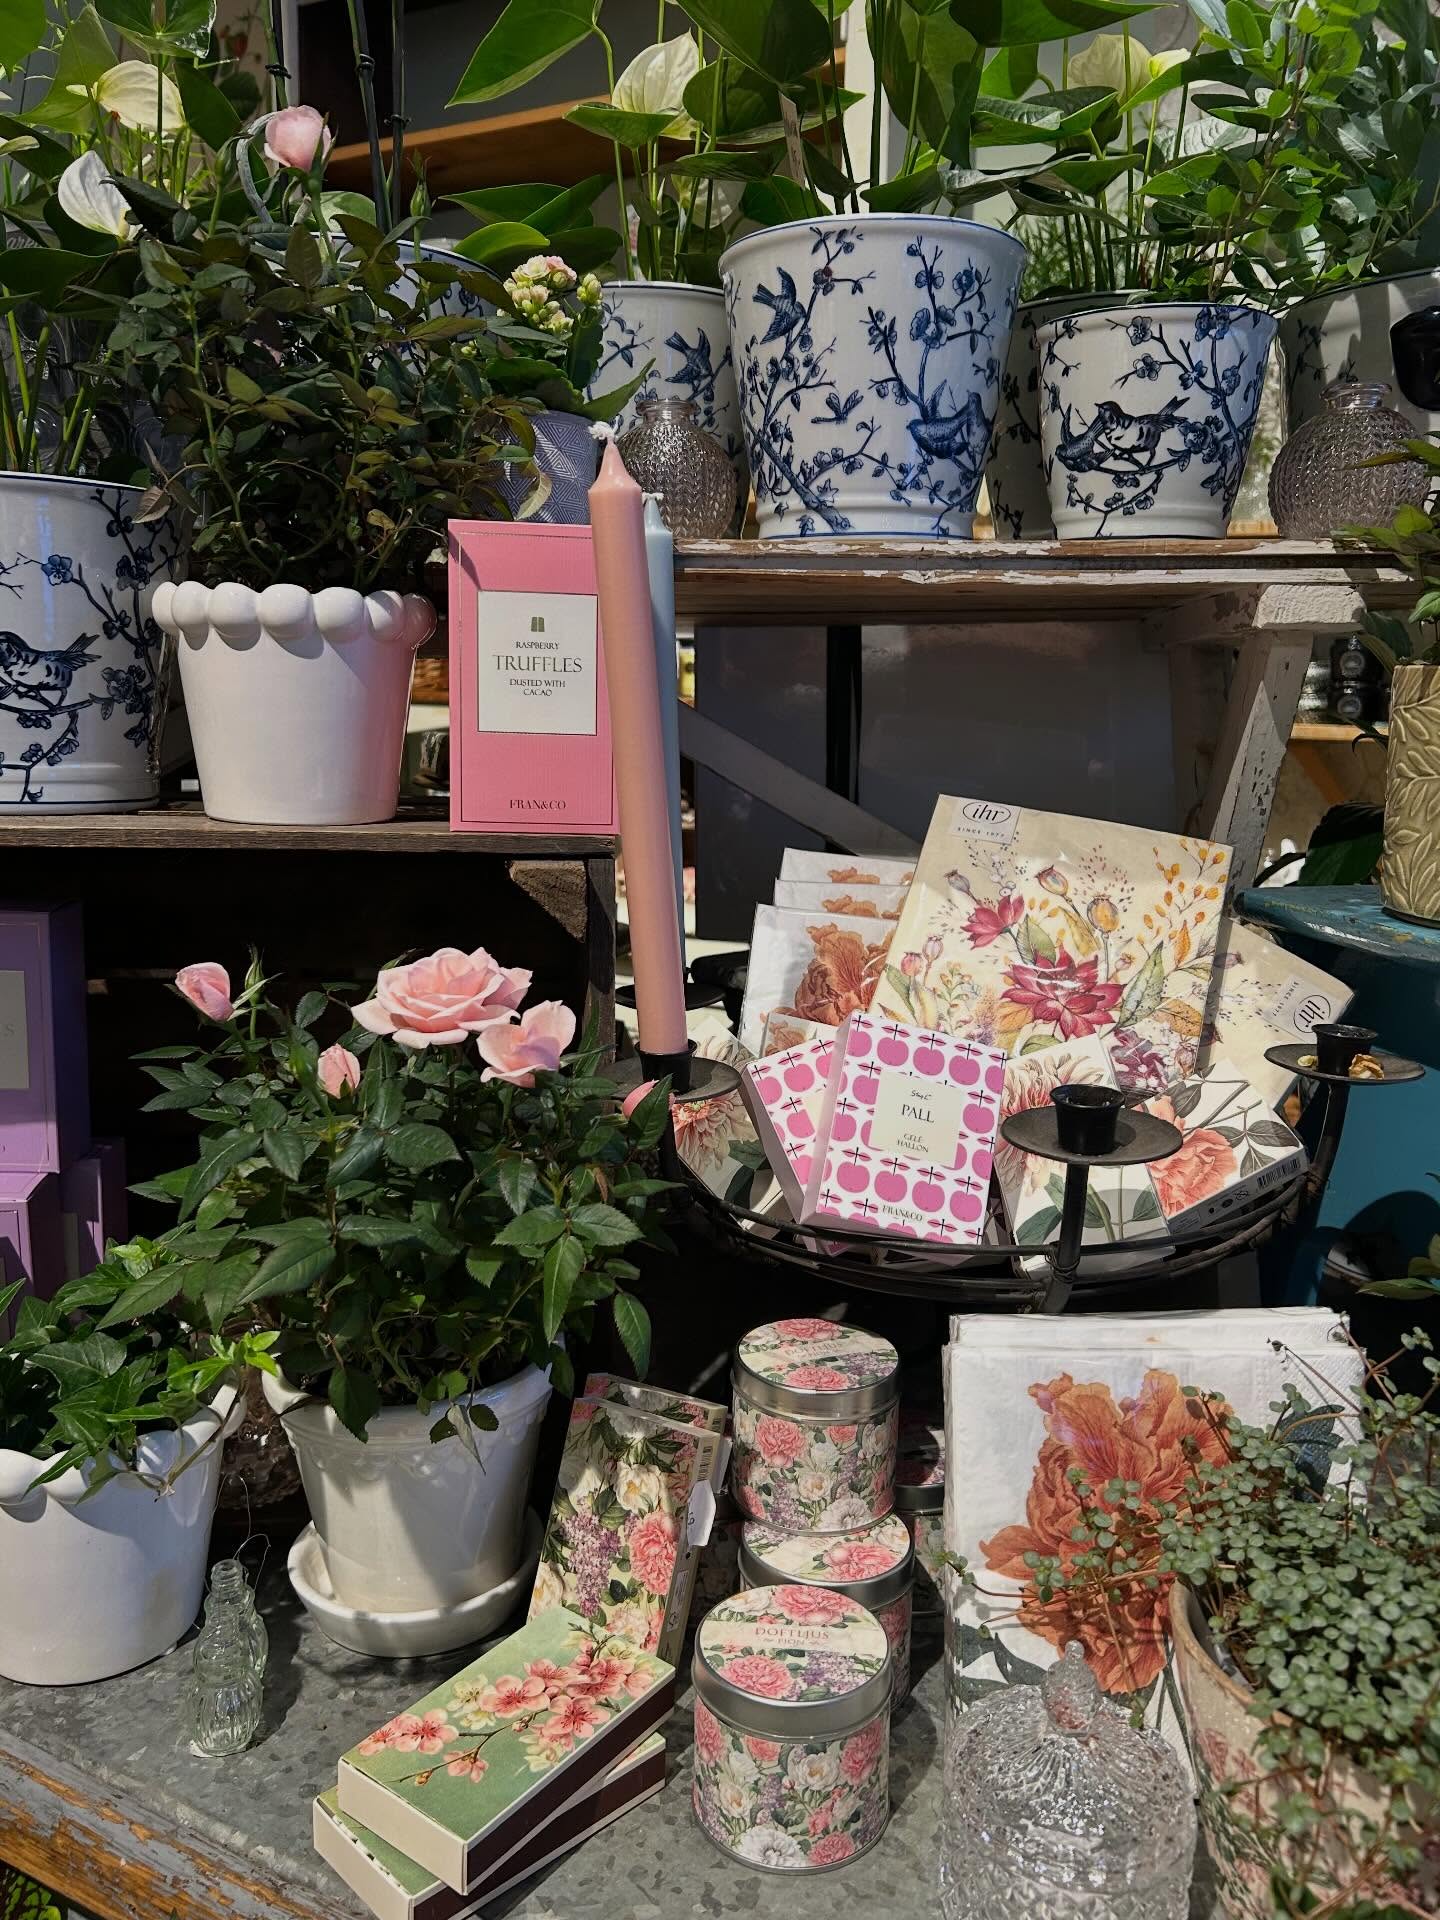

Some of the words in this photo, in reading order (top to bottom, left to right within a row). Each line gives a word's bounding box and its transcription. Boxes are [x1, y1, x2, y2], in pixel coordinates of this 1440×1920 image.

[515, 641, 560, 650] RASPBERRY
[491, 654, 583, 673] TRUFFLES
[509, 678, 543, 687] DUSTED
[544, 679, 566, 688] WITH
[523, 688, 553, 697] CACAO
[509, 799, 567, 810] FRAN&CO
[972, 804, 1005, 821] ihr
[896, 1139, 930, 1153] HALLON
[755, 1626, 830, 1640] DOFTLJUS
